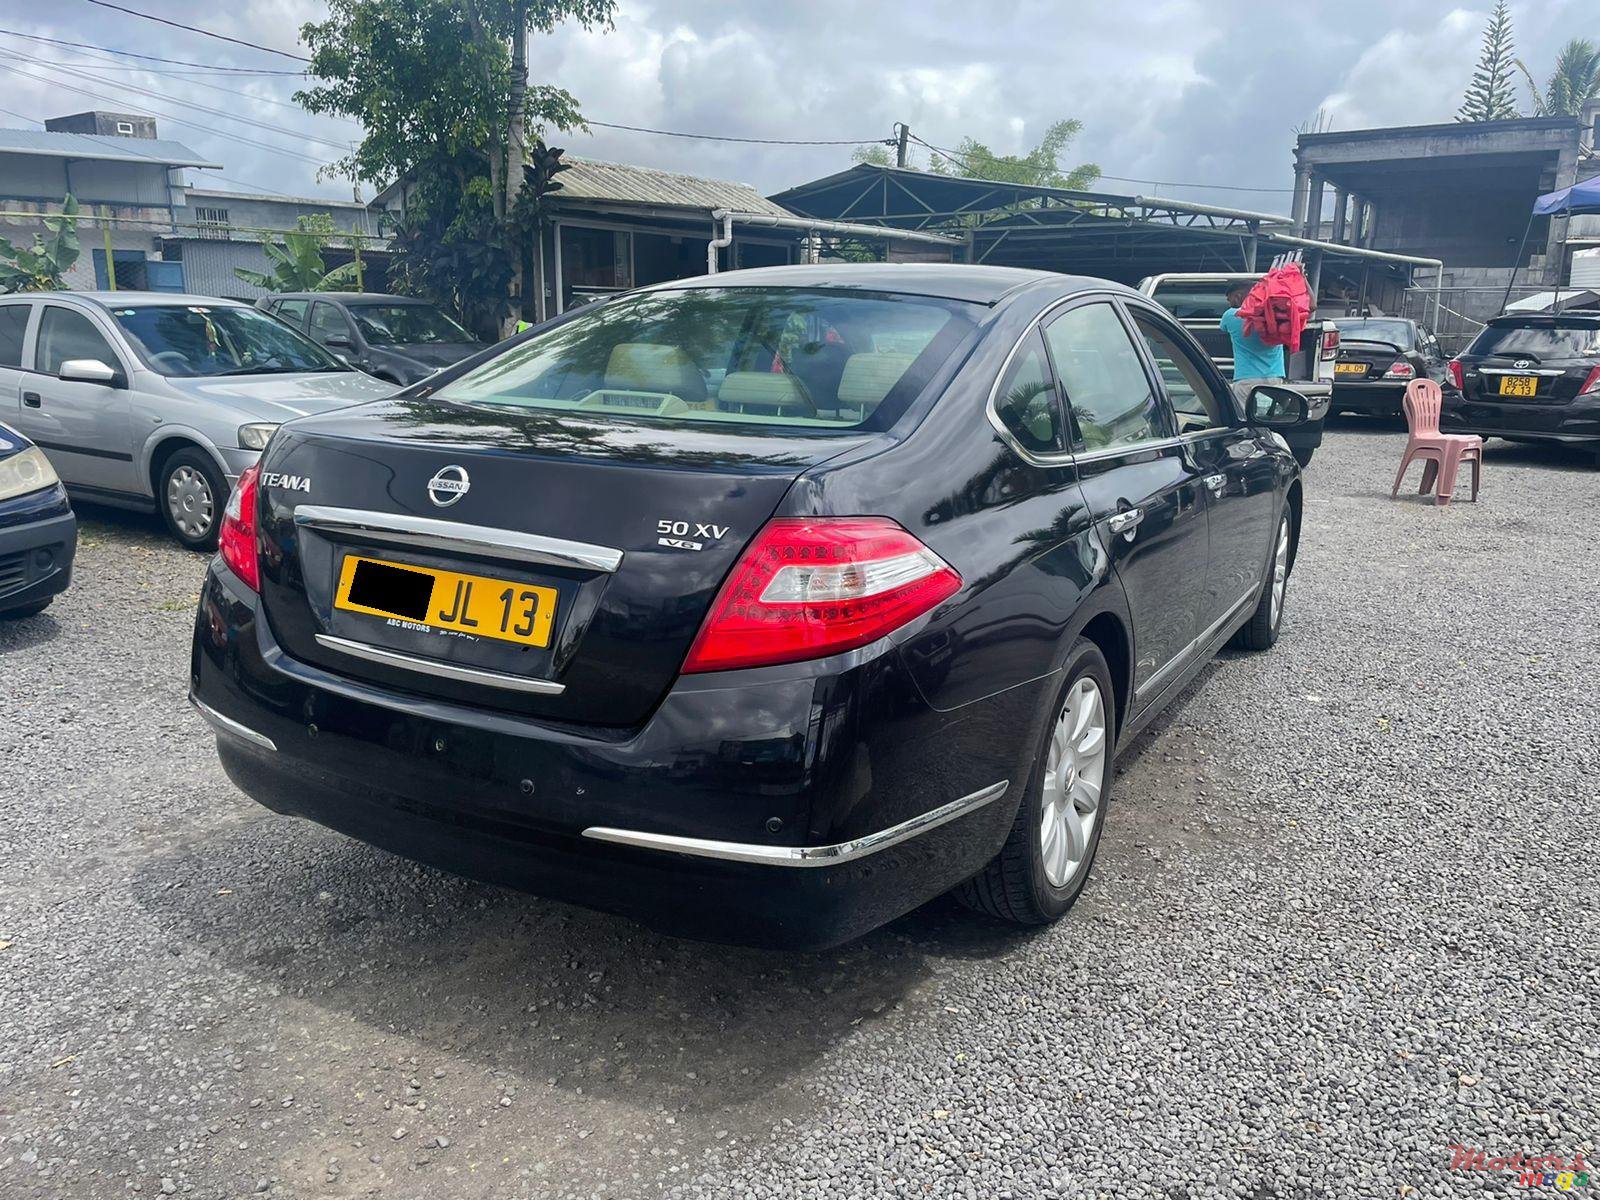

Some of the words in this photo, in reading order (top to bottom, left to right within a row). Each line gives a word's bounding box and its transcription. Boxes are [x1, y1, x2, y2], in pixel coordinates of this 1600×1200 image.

[1507, 377, 1531, 387] 8258
[1504, 386, 1516, 395] CZ
[1520, 386, 1531, 395] 13
[261, 472, 311, 493] TEANA
[430, 479, 464, 492] NISSAN
[656, 519, 690, 536] 50
[693, 523, 731, 540] XV
[666, 539, 695, 549] V6
[439, 580, 478, 627] JL
[499, 588, 540, 637] 13
[386, 618, 401, 627] ABC
[401, 620, 431, 633] MOTORS
